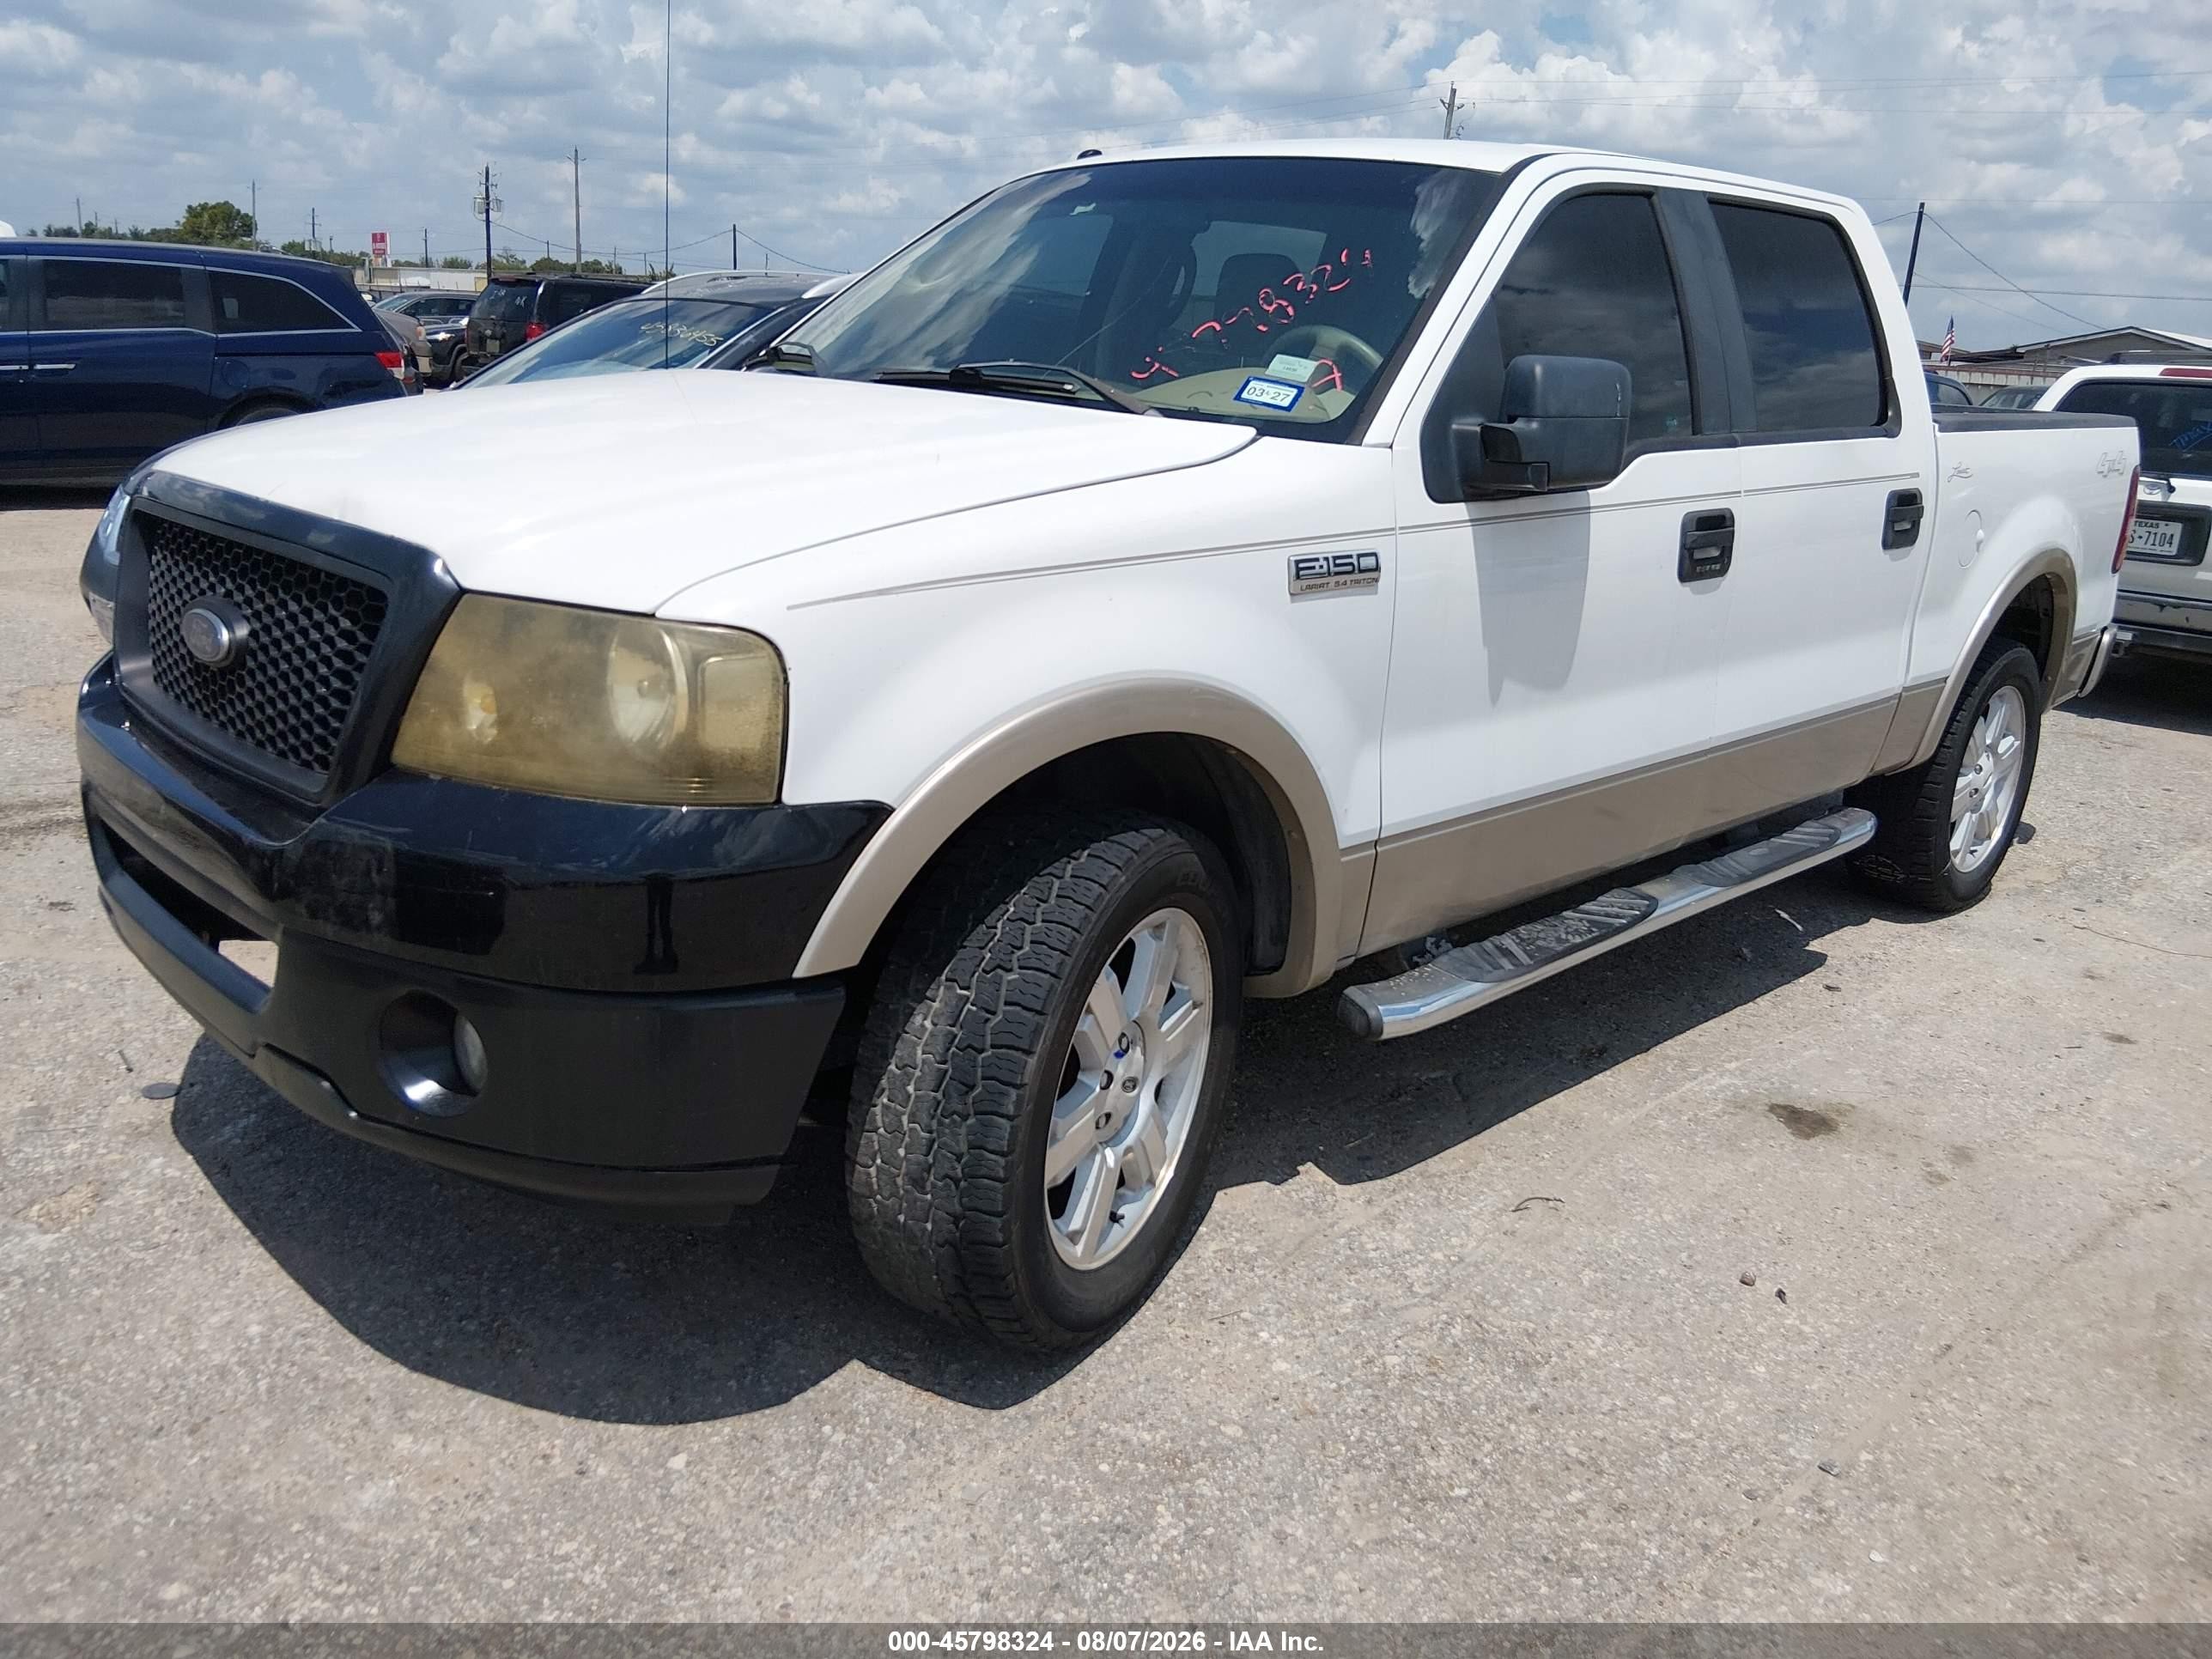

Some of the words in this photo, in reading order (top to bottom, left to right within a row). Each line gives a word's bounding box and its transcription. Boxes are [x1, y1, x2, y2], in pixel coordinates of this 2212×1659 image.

[1247, 386, 1266, 398] 03
[1270, 392, 1291, 403] 27
[1294, 552, 1379, 580] F-150
[1300, 581, 1330, 592] LARIAT
[1349, 576, 1380, 586] TRITON
